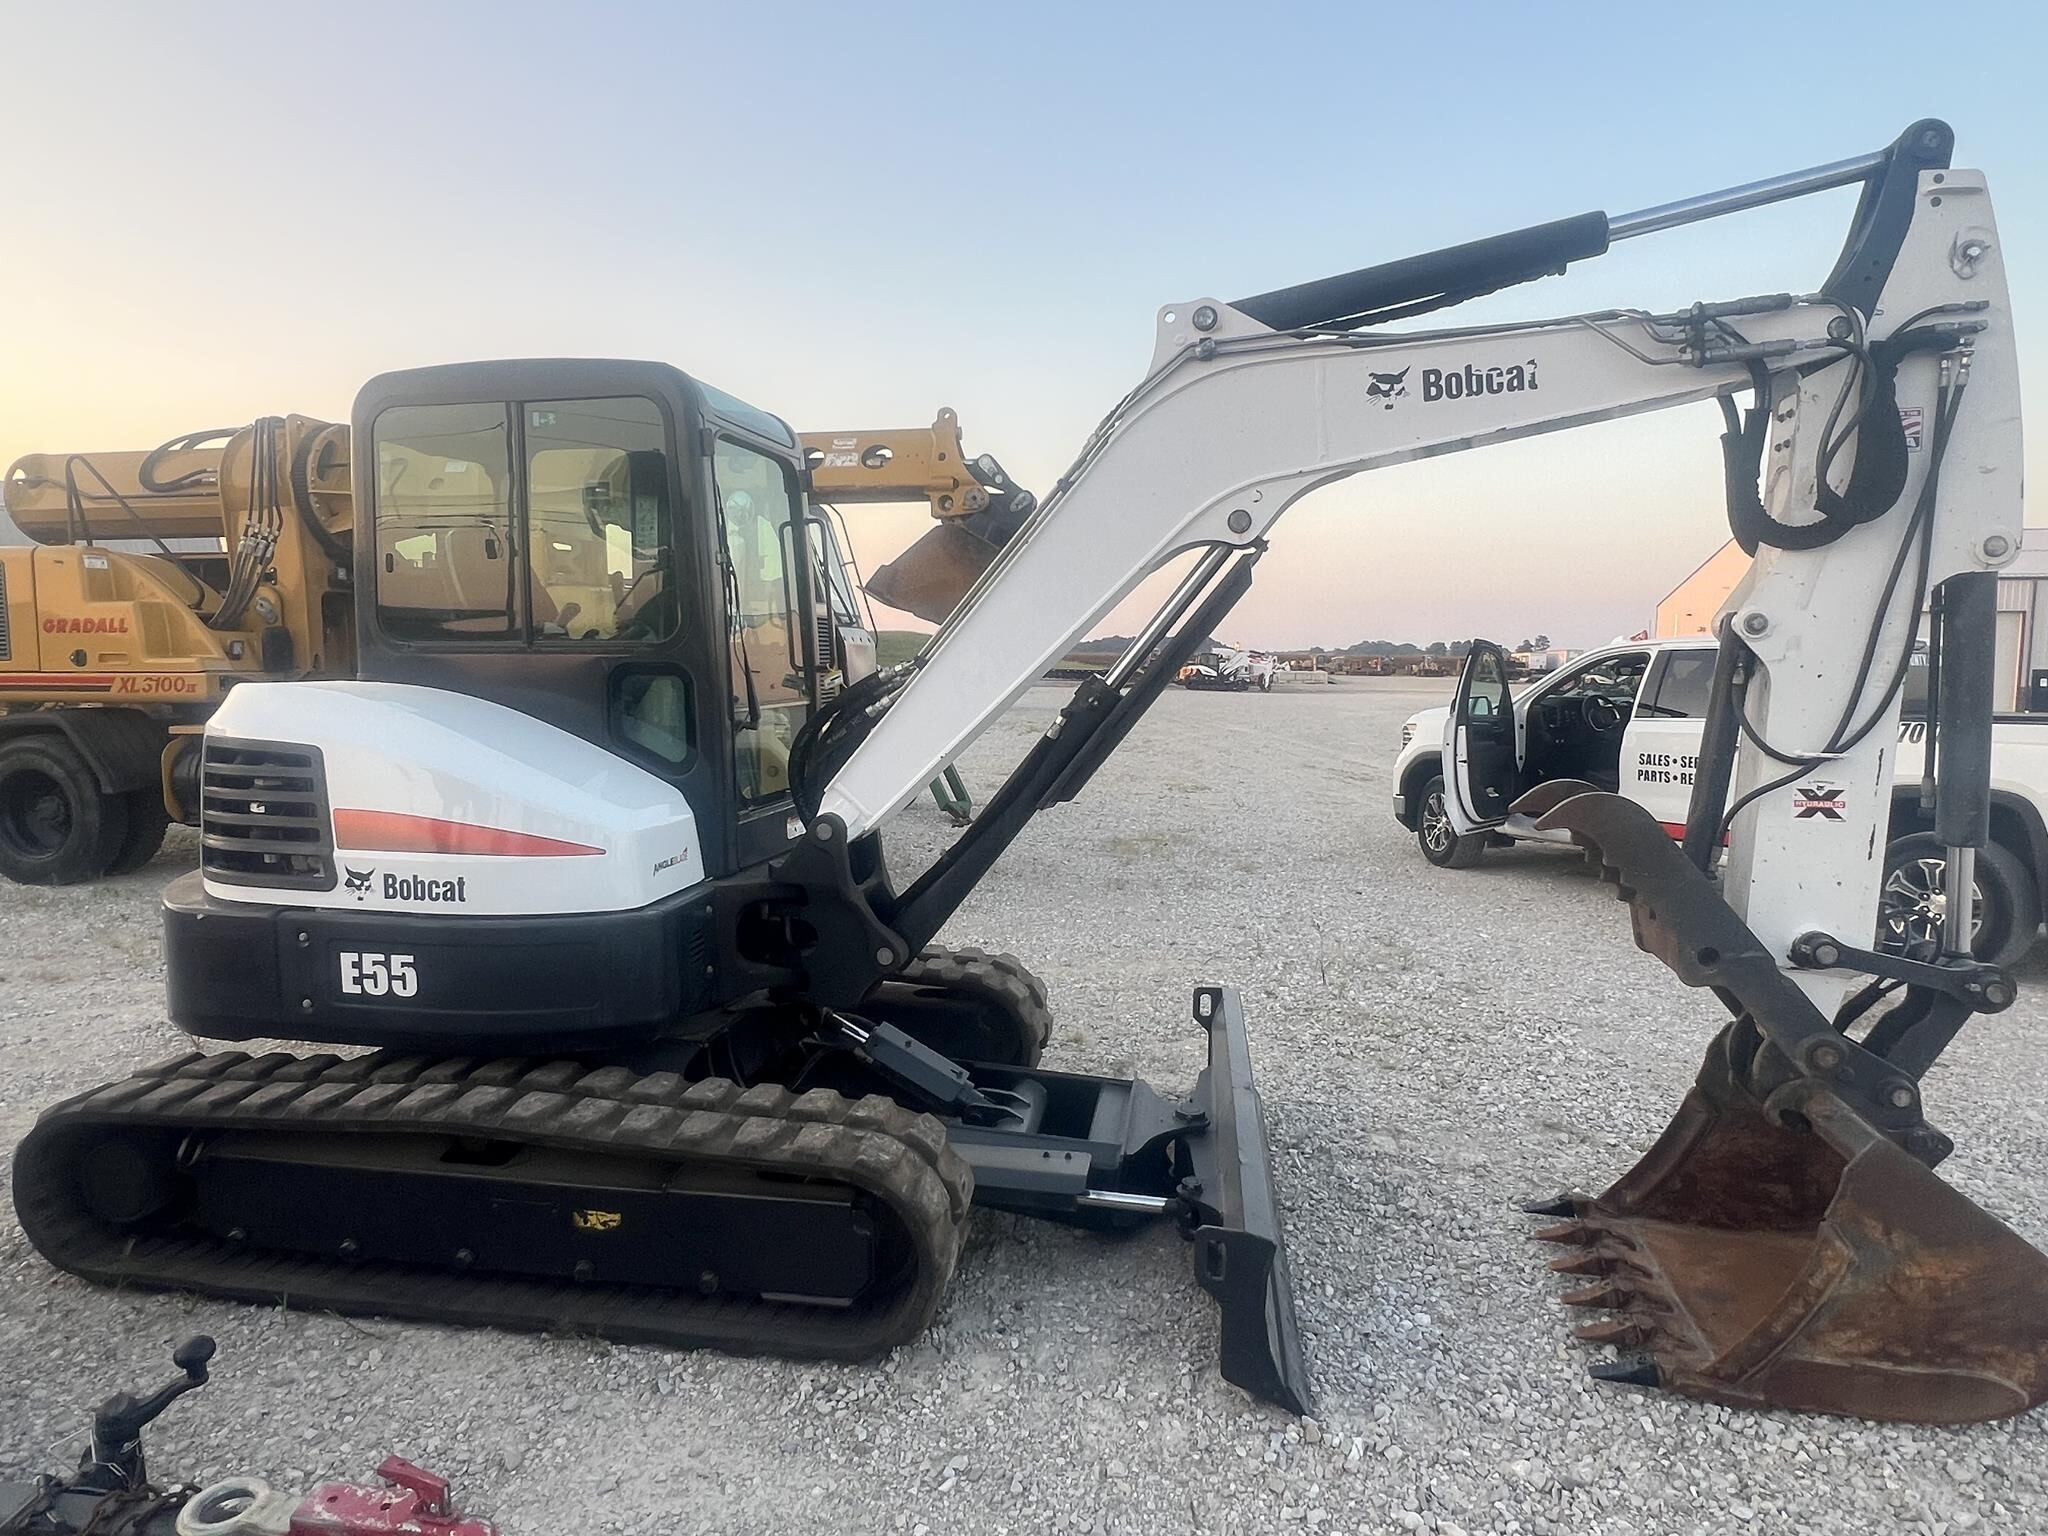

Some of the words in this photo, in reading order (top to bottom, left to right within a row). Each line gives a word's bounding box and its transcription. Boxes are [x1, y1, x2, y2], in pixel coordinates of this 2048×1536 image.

[1422, 358, 1538, 402] Bobcat
[43, 617, 129, 634] GRADALL
[1897, 722, 1940, 744] 70
[1639, 753, 1671, 767] SALES
[1637, 769, 1671, 784] PARTS
[383, 873, 466, 902] Bobcat
[339, 952, 418, 997] E55
